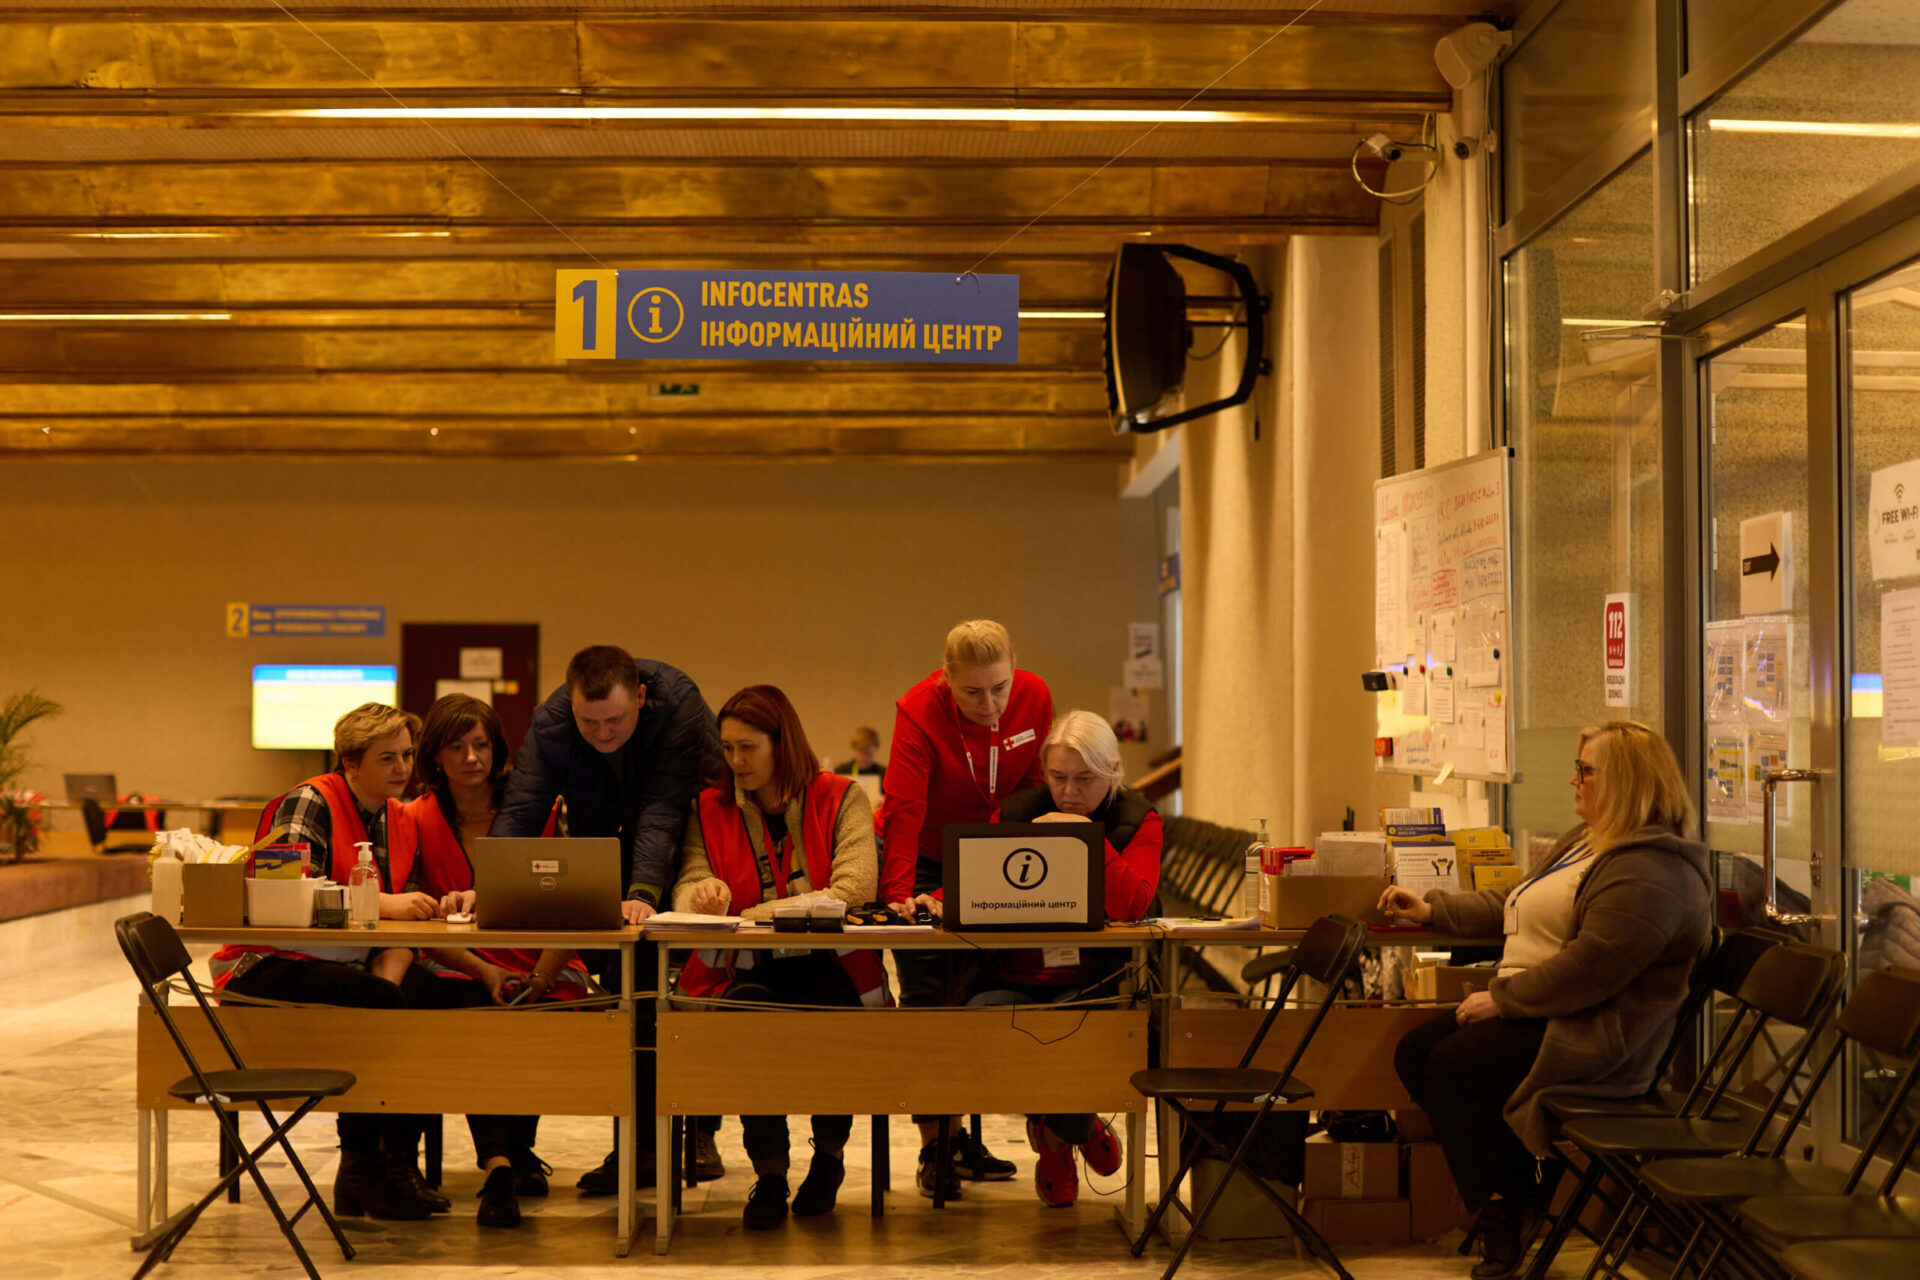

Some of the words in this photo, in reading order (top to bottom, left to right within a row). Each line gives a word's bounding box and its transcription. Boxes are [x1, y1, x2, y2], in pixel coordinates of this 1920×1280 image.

[701, 281, 869, 309] INFOCENTRAS
[572, 279, 598, 351] 1
[700, 317, 916, 352] ІНФОРМАЦІЙНИЙ
[924, 323, 1003, 353] ЦЕНТР
[1882, 509, 1899, 525] FREE
[232, 608, 244, 633] 2
[1609, 612, 1623, 638] 112
[971, 900, 1045, 910] інформаційний
[1048, 900, 1077, 909] центр
